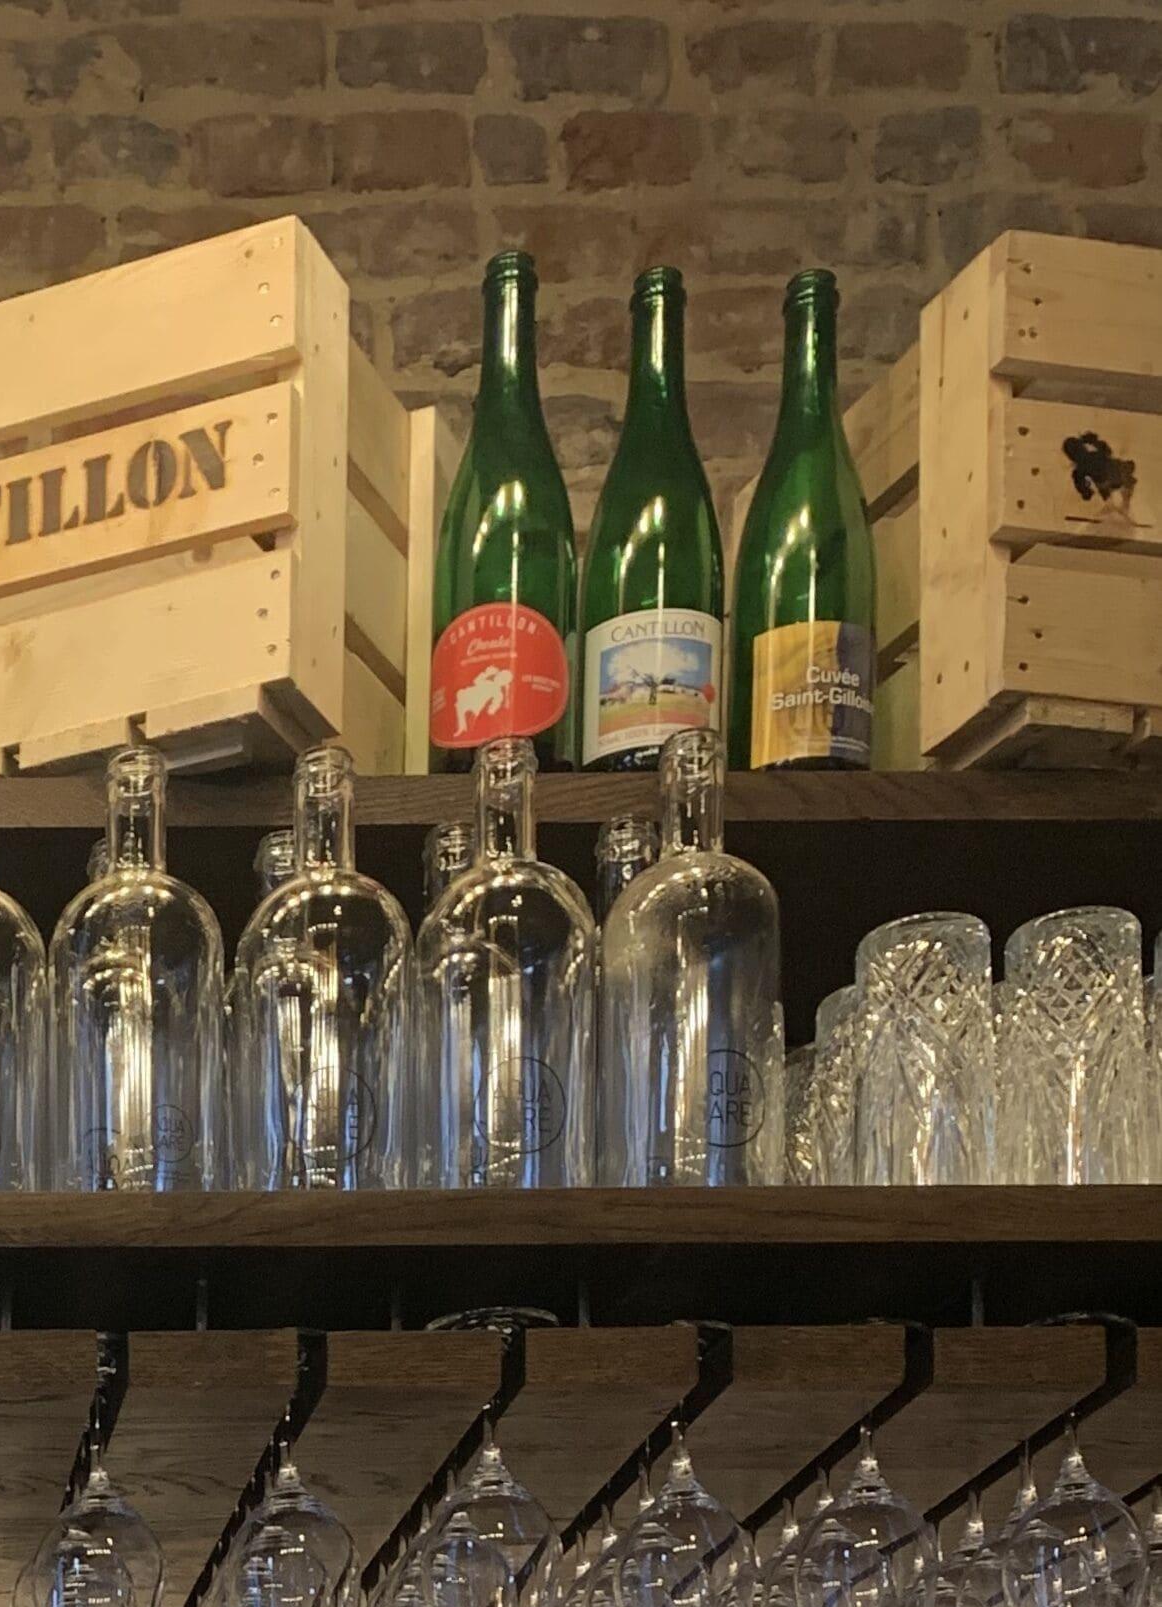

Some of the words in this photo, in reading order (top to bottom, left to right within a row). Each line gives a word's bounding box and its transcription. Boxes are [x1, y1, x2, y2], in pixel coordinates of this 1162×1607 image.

[610, 619, 706, 642] CANTLLON
[806, 665, 861, 687] Cuvée
[709, 1070, 752, 1096] QUA
[709, 1100, 752, 1127] ARE
